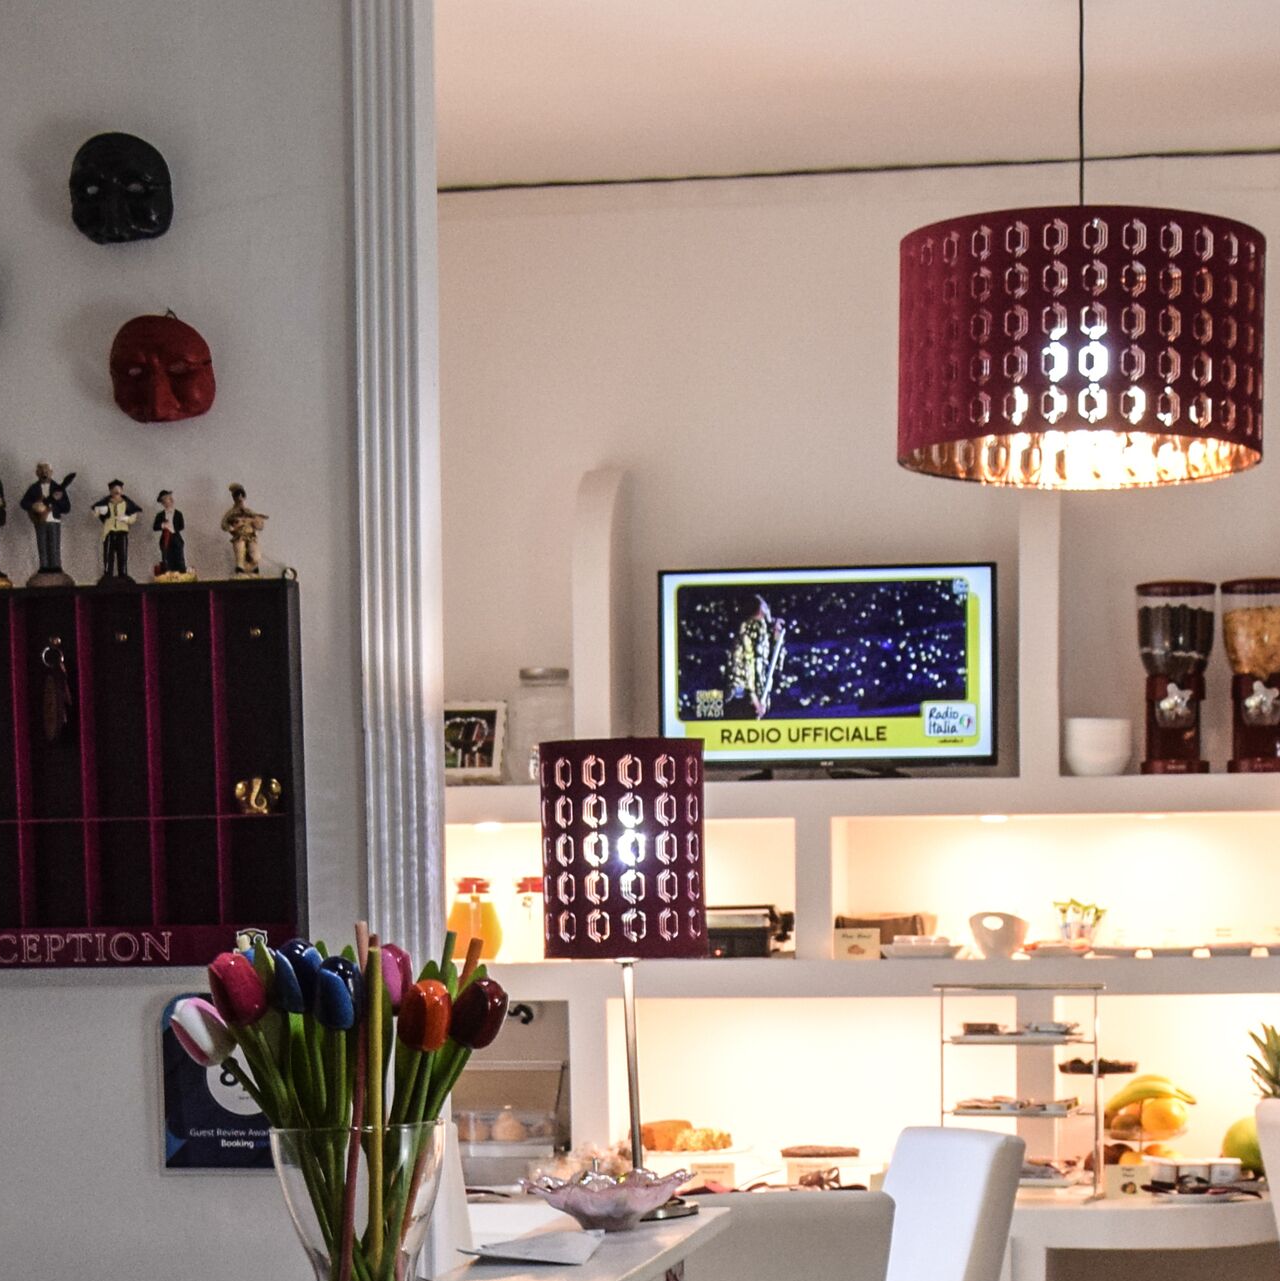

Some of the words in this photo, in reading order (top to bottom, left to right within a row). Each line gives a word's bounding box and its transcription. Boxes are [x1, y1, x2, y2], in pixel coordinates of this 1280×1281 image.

[928, 706, 959, 719] Radio
[928, 721, 958, 734] Italia
[720, 727, 781, 744] RADIO
[787, 726, 888, 743] UFFICIALE
[189, 1128, 214, 1137] Guest
[216, 1128, 246, 1137] Review
